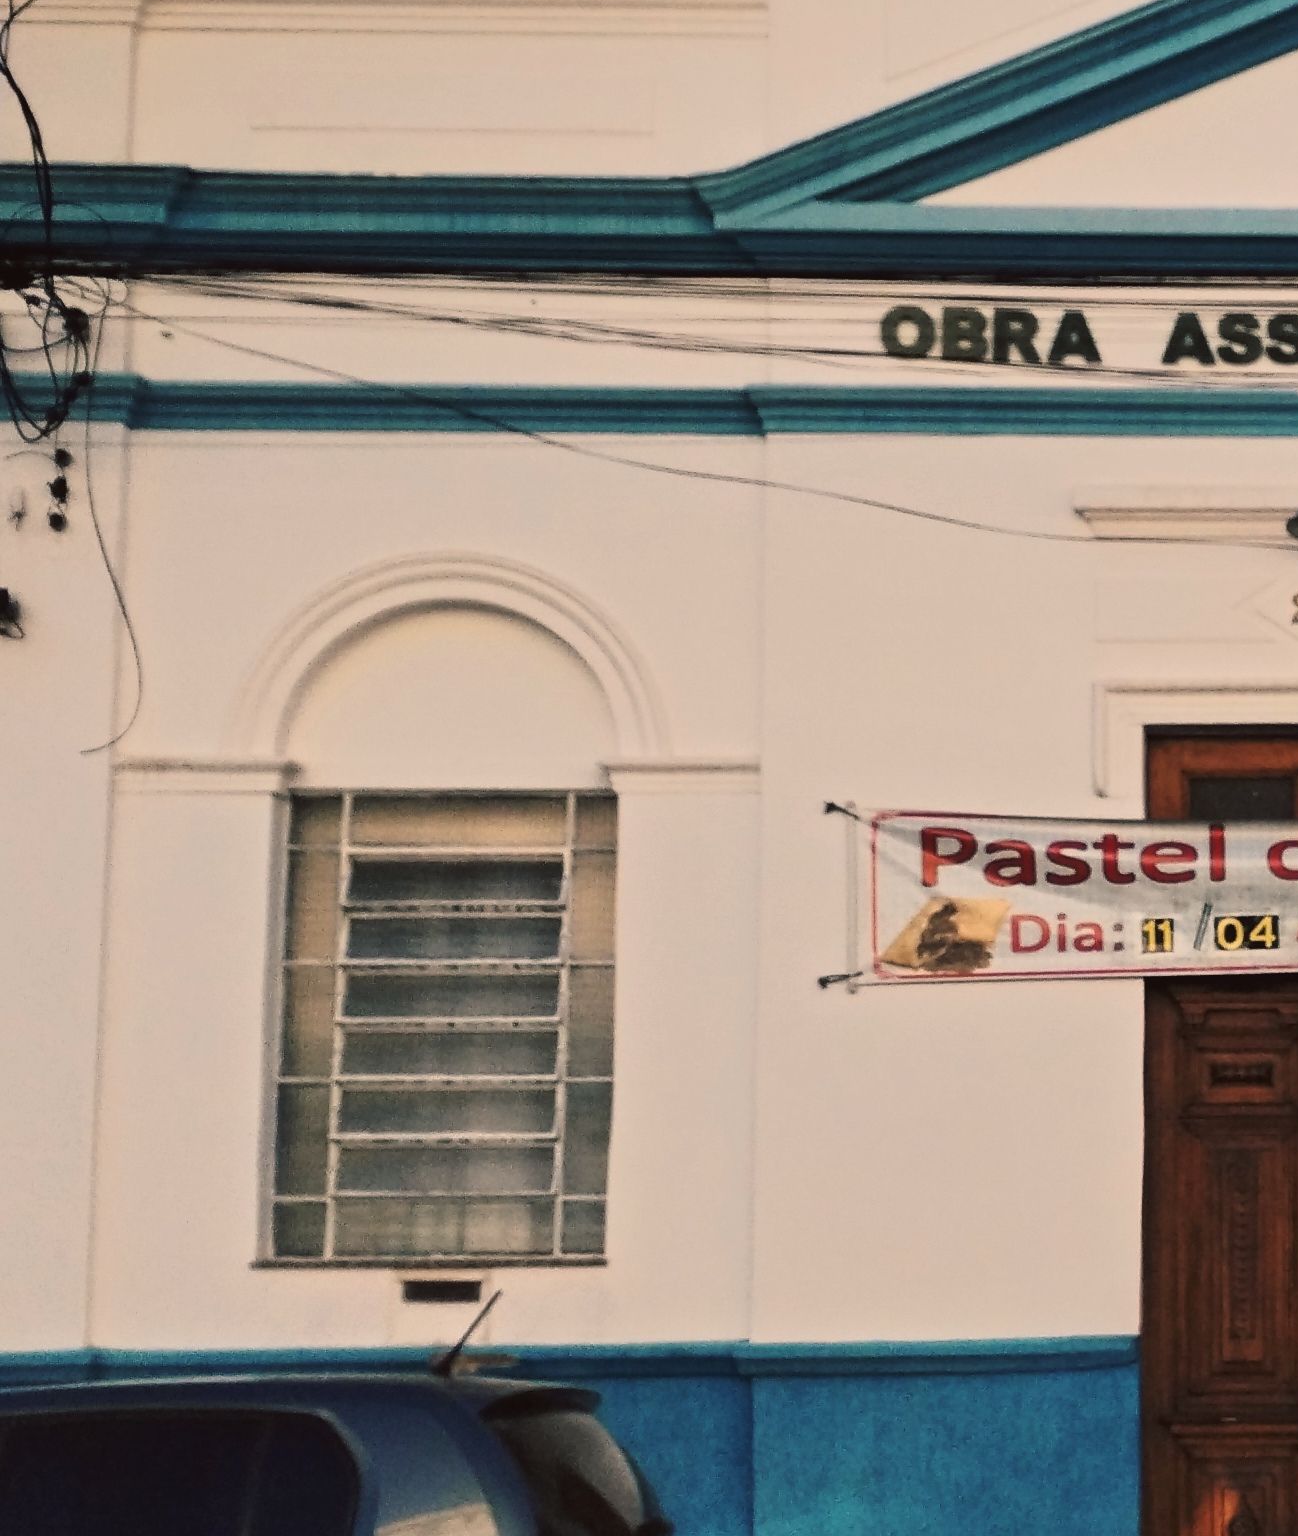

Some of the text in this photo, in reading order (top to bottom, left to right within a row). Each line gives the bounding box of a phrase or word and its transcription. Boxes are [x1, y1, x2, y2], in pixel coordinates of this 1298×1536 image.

[880, 305, 1102, 365] OBRA
[920, 824, 1226, 887] Pastel
[1009, 912, 1124, 954] Dia:
